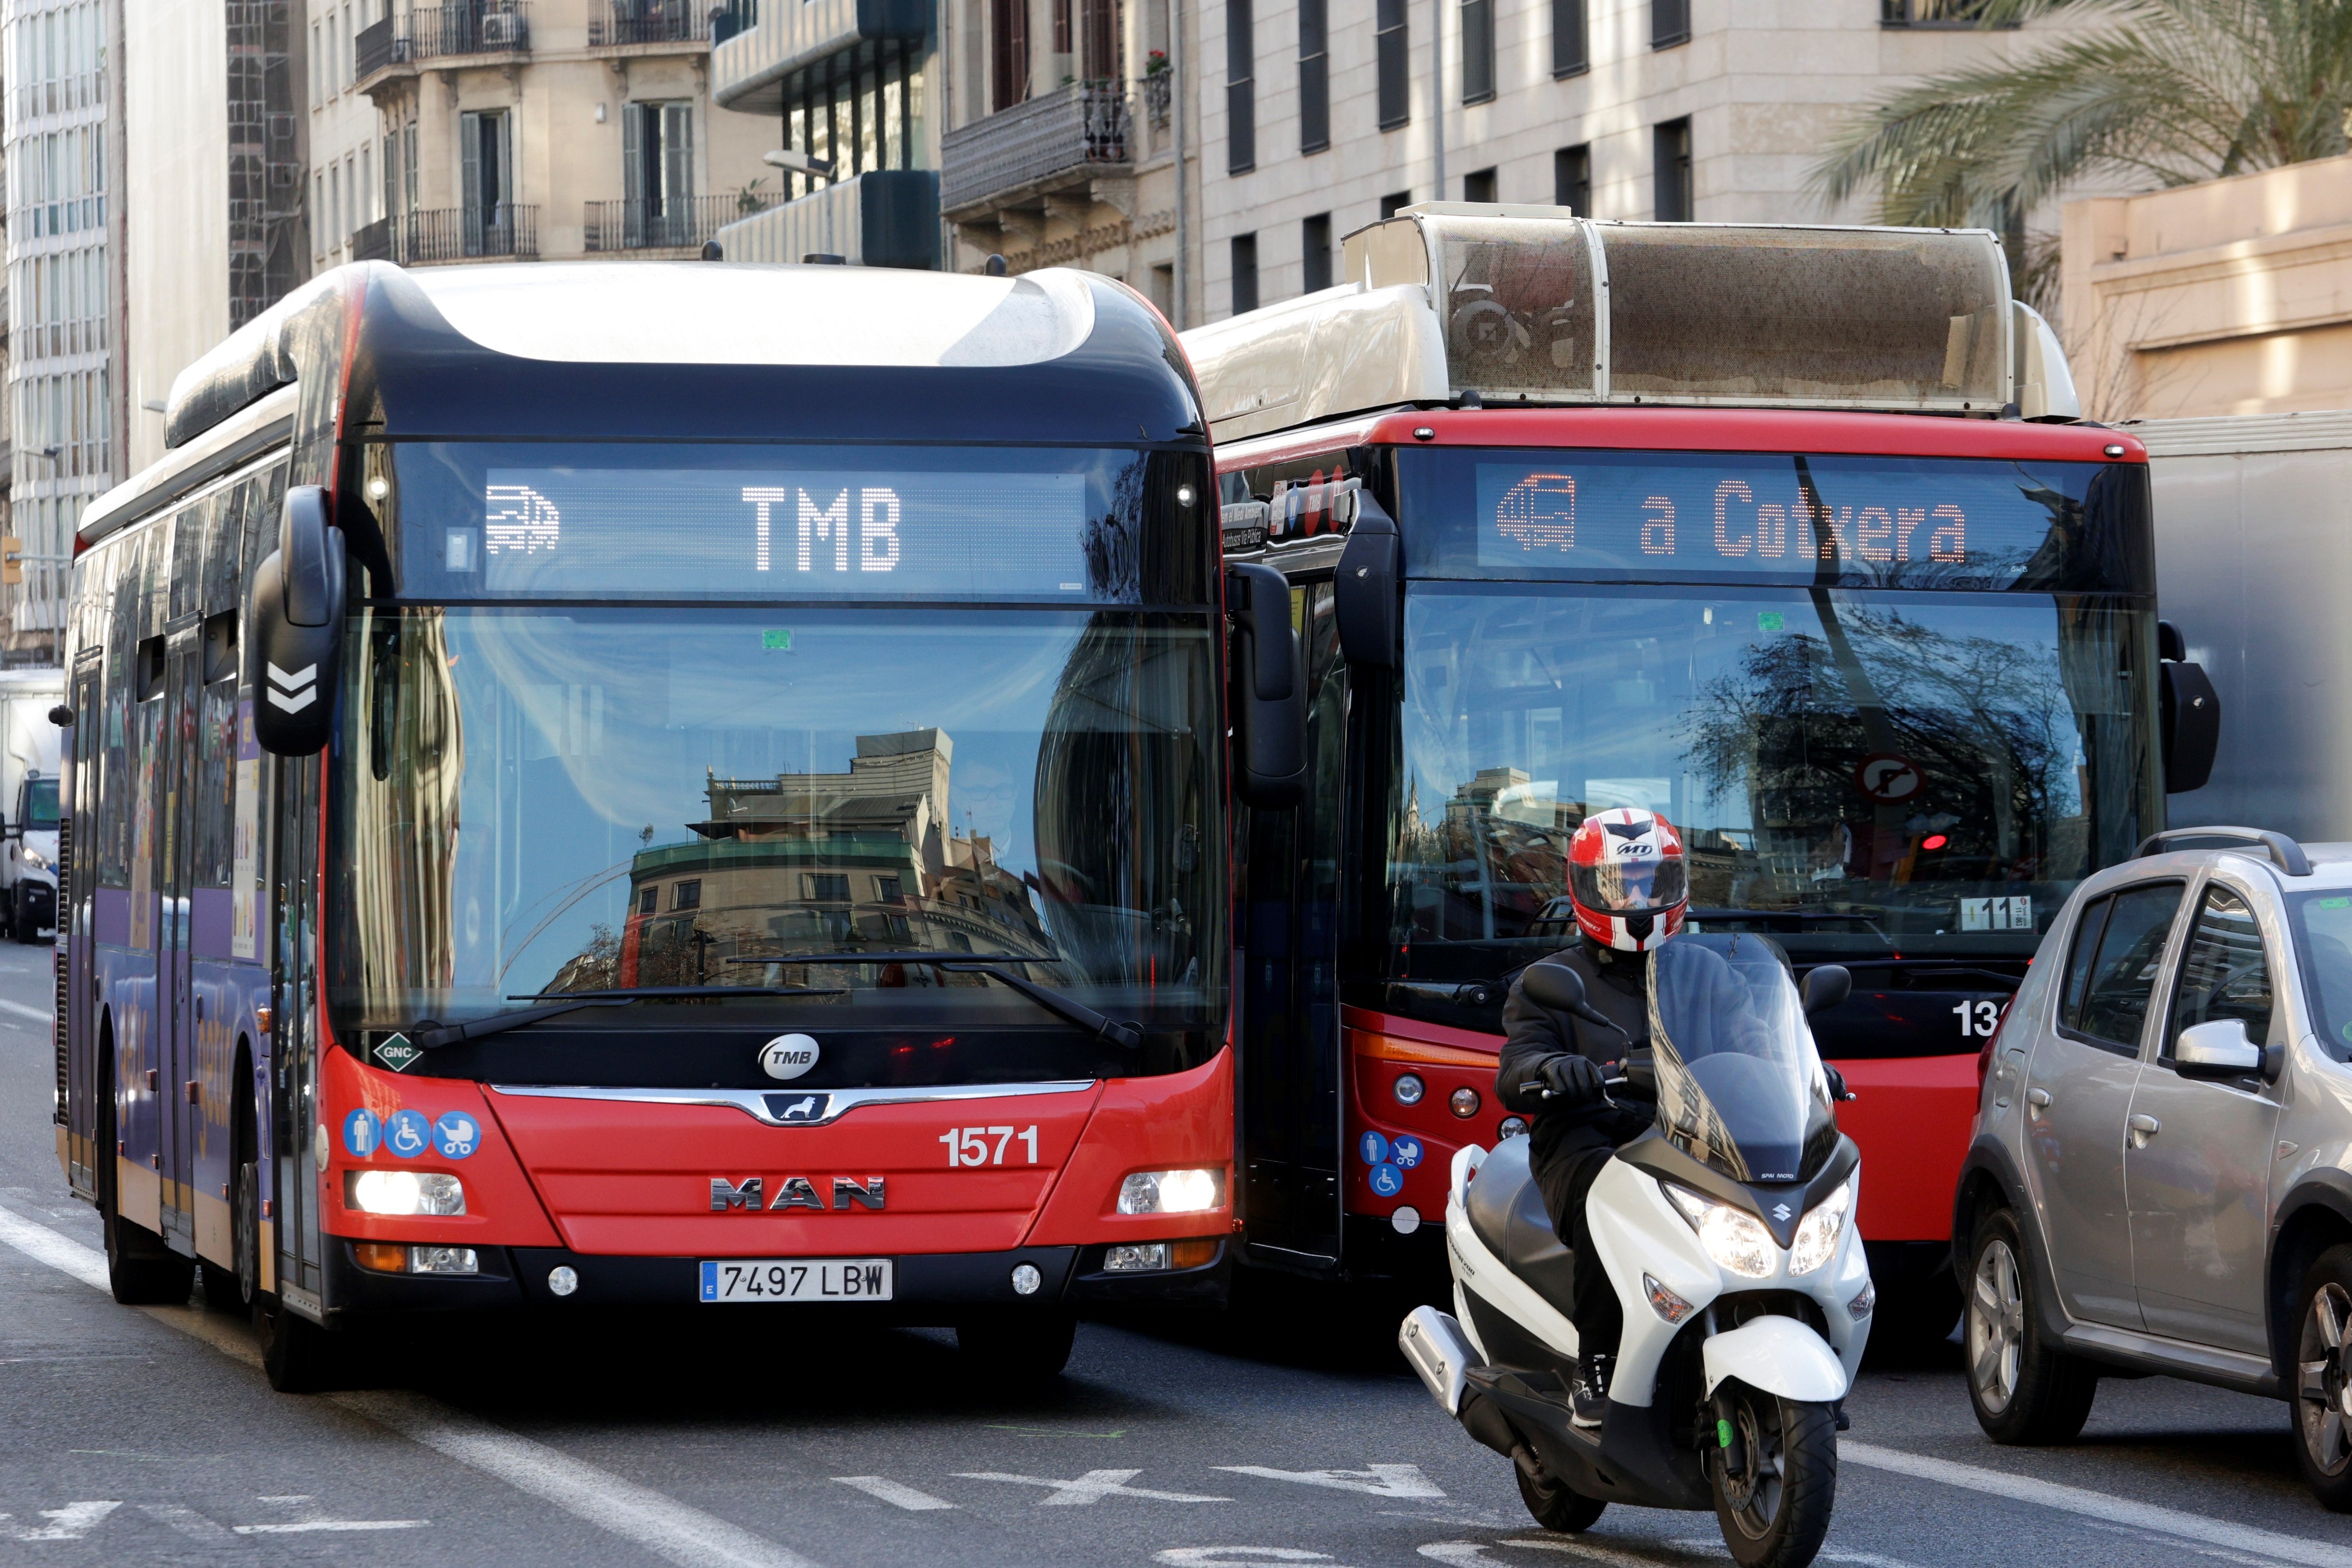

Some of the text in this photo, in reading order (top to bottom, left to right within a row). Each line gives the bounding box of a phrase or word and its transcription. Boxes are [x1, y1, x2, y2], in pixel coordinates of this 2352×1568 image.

[1308, 494, 1321, 513] TMB
[742, 487, 900, 572] TMB
[1641, 479, 1966, 563] a Cotxera
[1222, 532, 1241, 548] Autobusos
[1616, 845, 1652, 855] MT
[1982, 897, 2011, 929] 11
[383, 1046, 412, 1059] GNC
[772, 1050, 812, 1066] TMB
[939, 1125, 1038, 1167] 1571
[710, 1177, 885, 1211] MAN
[706, 1286, 714, 1295] E
[724, 1265, 883, 1296] 7497 LBW
